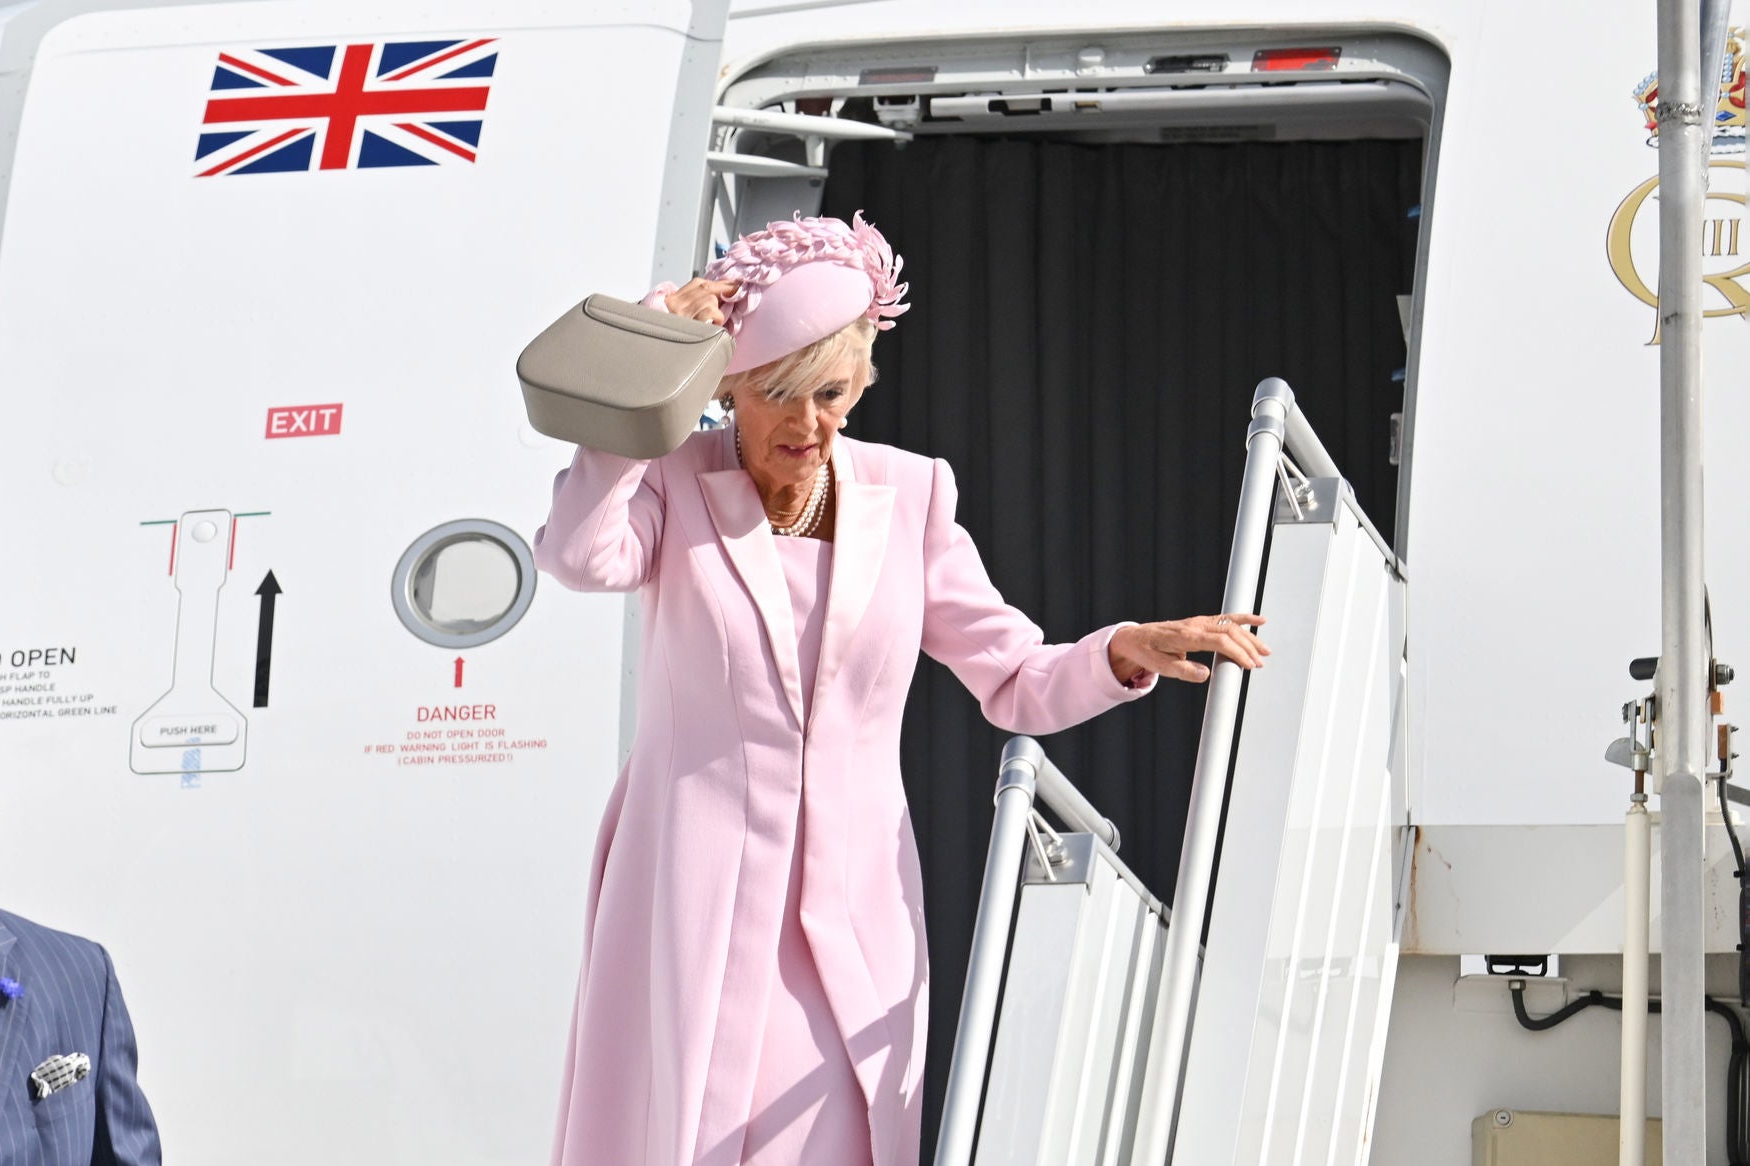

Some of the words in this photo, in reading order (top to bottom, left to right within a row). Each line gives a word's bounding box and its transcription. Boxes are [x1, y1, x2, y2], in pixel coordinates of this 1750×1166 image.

[271, 408, 338, 434] EXIT
[11, 646, 76, 668] OPEN
[9, 671, 35, 681] FLAP
[38, 670, 51, 680] TO
[14, 683, 56, 693] HANDLE
[2, 696, 43, 707] HANDLE
[45, 694, 77, 705] FULLY
[79, 693, 94, 703] UP
[57, 706, 92, 717] GREEN
[94, 705, 118, 715] LINE
[417, 704, 497, 723] DANGER
[159, 726, 188, 736] PUSH
[190, 724, 218, 735] HERE
[406, 731, 421, 741] DO
[423, 730, 443, 740] NOT
[446, 729, 474, 739] OPEN
[477, 728, 506, 738] DOOR
[364, 744, 373, 754] IF
[376, 744, 395, 754] RED
[400, 743, 447, 753] WARNING
[451, 742, 480, 751] LIGHT
[485, 741, 494, 750] IS
[497, 739, 547, 750] FLASHING
